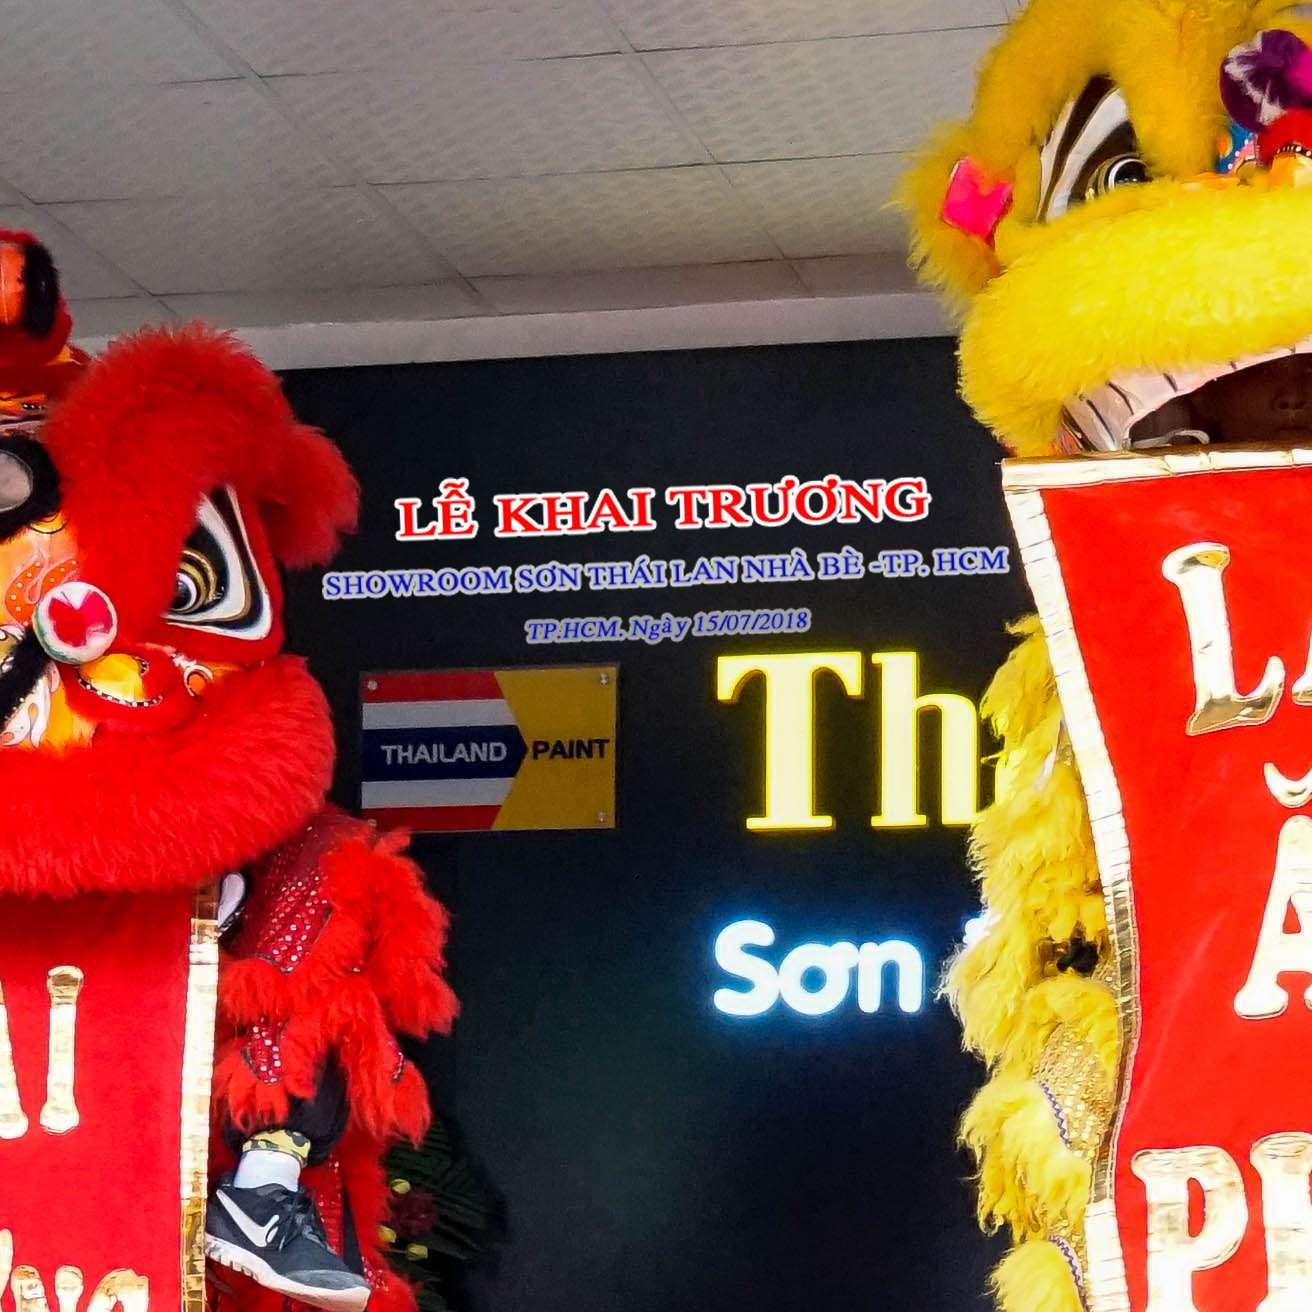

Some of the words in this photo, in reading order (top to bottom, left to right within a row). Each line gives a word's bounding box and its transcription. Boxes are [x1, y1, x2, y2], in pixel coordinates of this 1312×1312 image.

[395, 477, 478, 541] LỄ
[494, 488, 655, 537] KHAI
[667, 474, 932, 530] TRƯƠNG
[322, 568, 508, 600] SHOWROOM
[515, 560, 581, 593] SƠN
[585, 555, 666, 589] THÁI
[670, 556, 740, 588] LAN
[742, 548, 813, 581] NHÀ
[818, 545, 863, 577] BÈ
[934, 546, 1010, 575] HCM
[629, 612, 690, 645] Ngày
[692, 608, 811, 637] 15/07/2018
[381, 742, 507, 765] THAILAND
[533, 738, 610, 760] PAINT
[716, 651, 988, 831] Th
[713, 918, 923, 1016] Sơn
